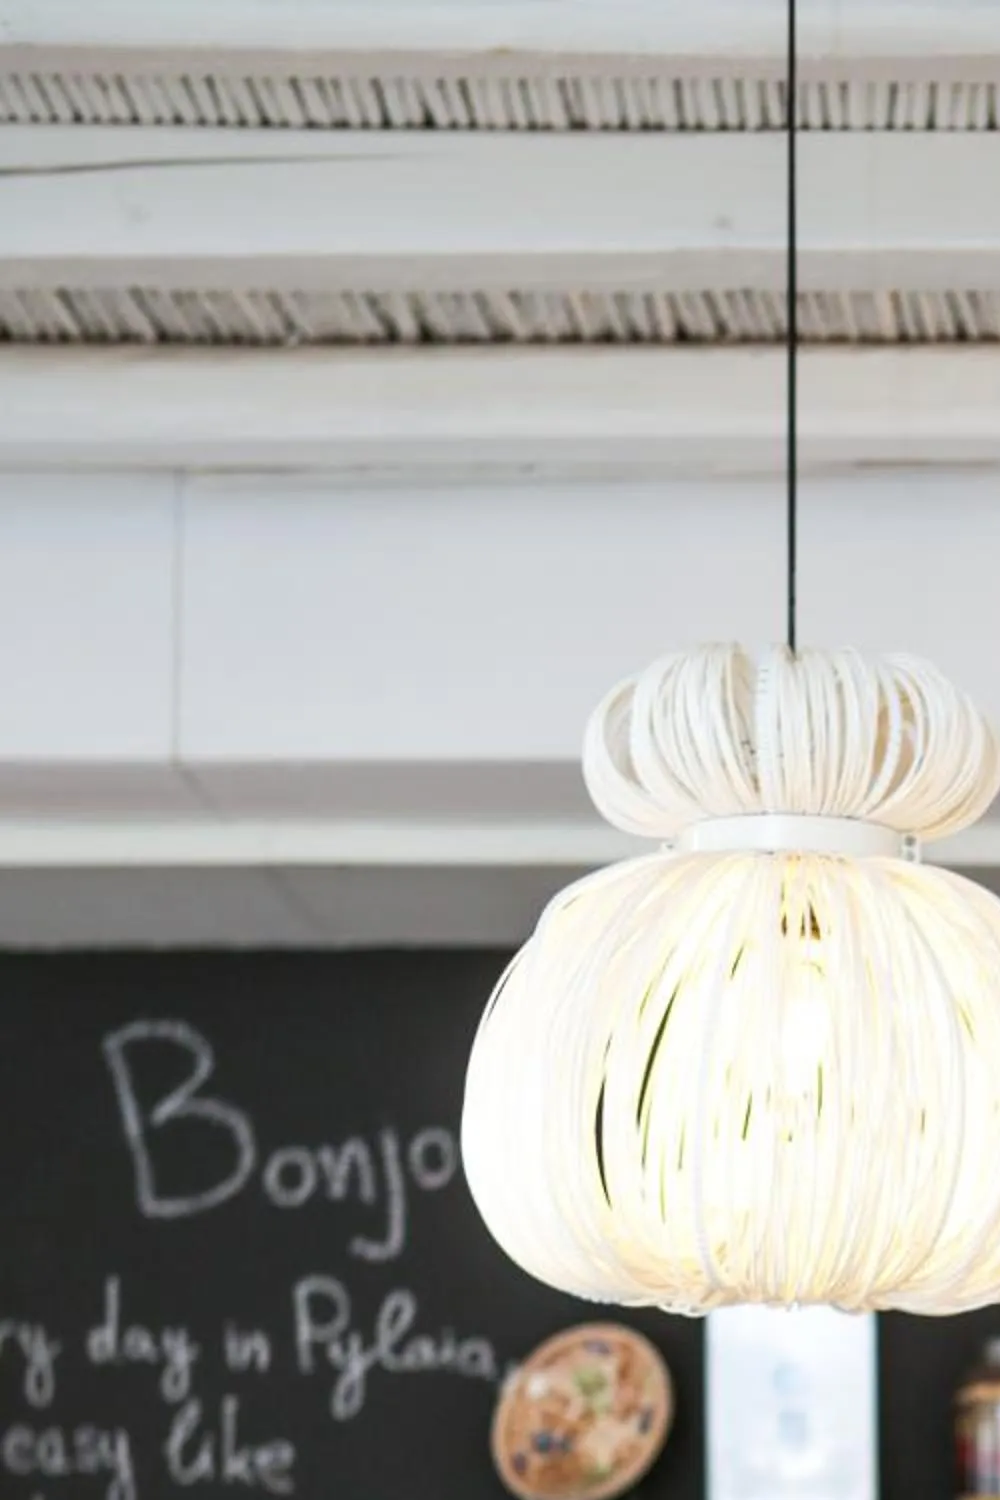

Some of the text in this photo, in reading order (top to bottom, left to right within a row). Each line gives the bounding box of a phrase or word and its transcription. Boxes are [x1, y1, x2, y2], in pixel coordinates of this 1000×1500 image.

[86, 1273, 198, 1402] day
[225, 1320, 271, 1375] in
[165, 1395, 297, 1496] like
